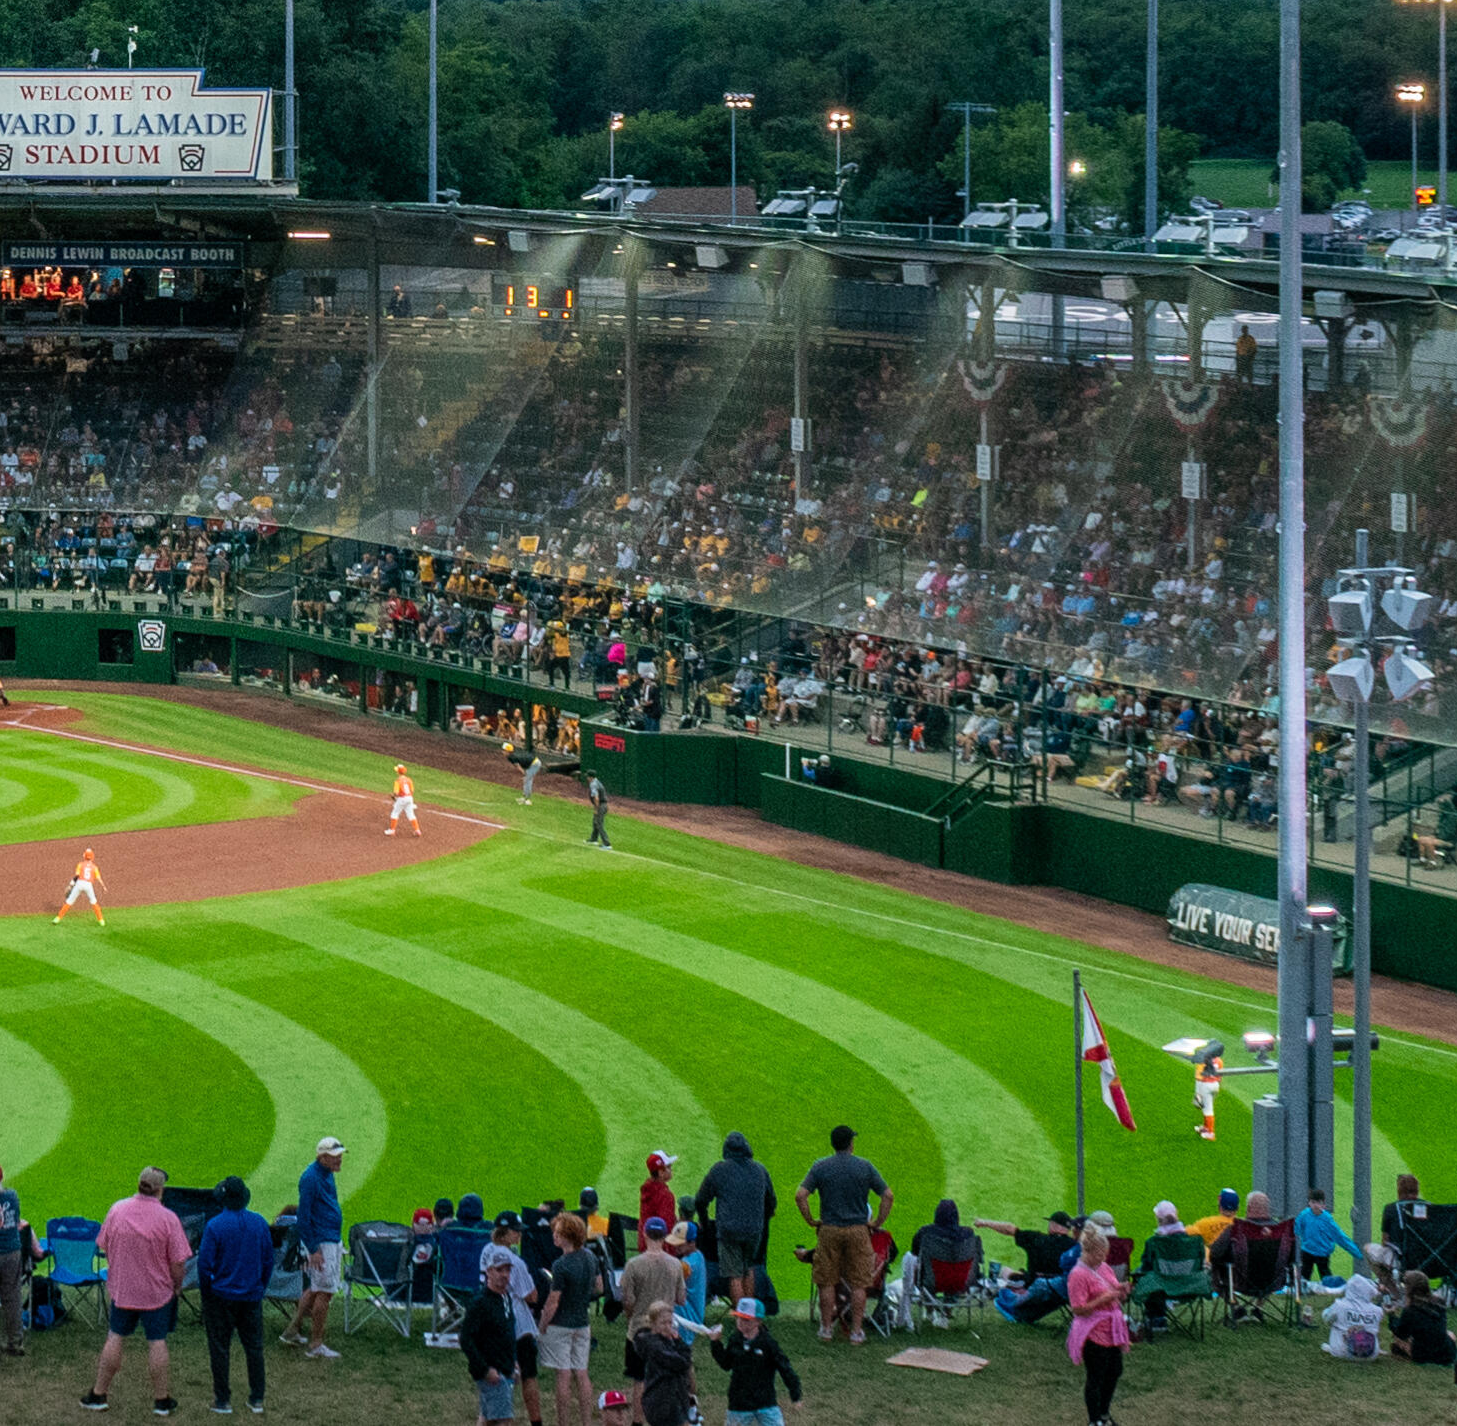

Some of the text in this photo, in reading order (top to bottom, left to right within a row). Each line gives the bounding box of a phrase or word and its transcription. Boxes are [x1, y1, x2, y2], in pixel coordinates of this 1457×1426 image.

[19, 85, 172, 101] WELCOME TO
[85, 112, 104, 137] J.
[113, 112, 248, 137] LAMADE
[24, 144, 161, 165] STADIUM
[10, 247, 235, 261] DENNIS LEWIN BROADCAST BOOTH
[526, 285, 539, 308] 3
[1177, 902, 1212, 934] LIVE
[1214, 911, 1253, 945] YOUR
[1347, 1312, 1377, 1324] NASA
